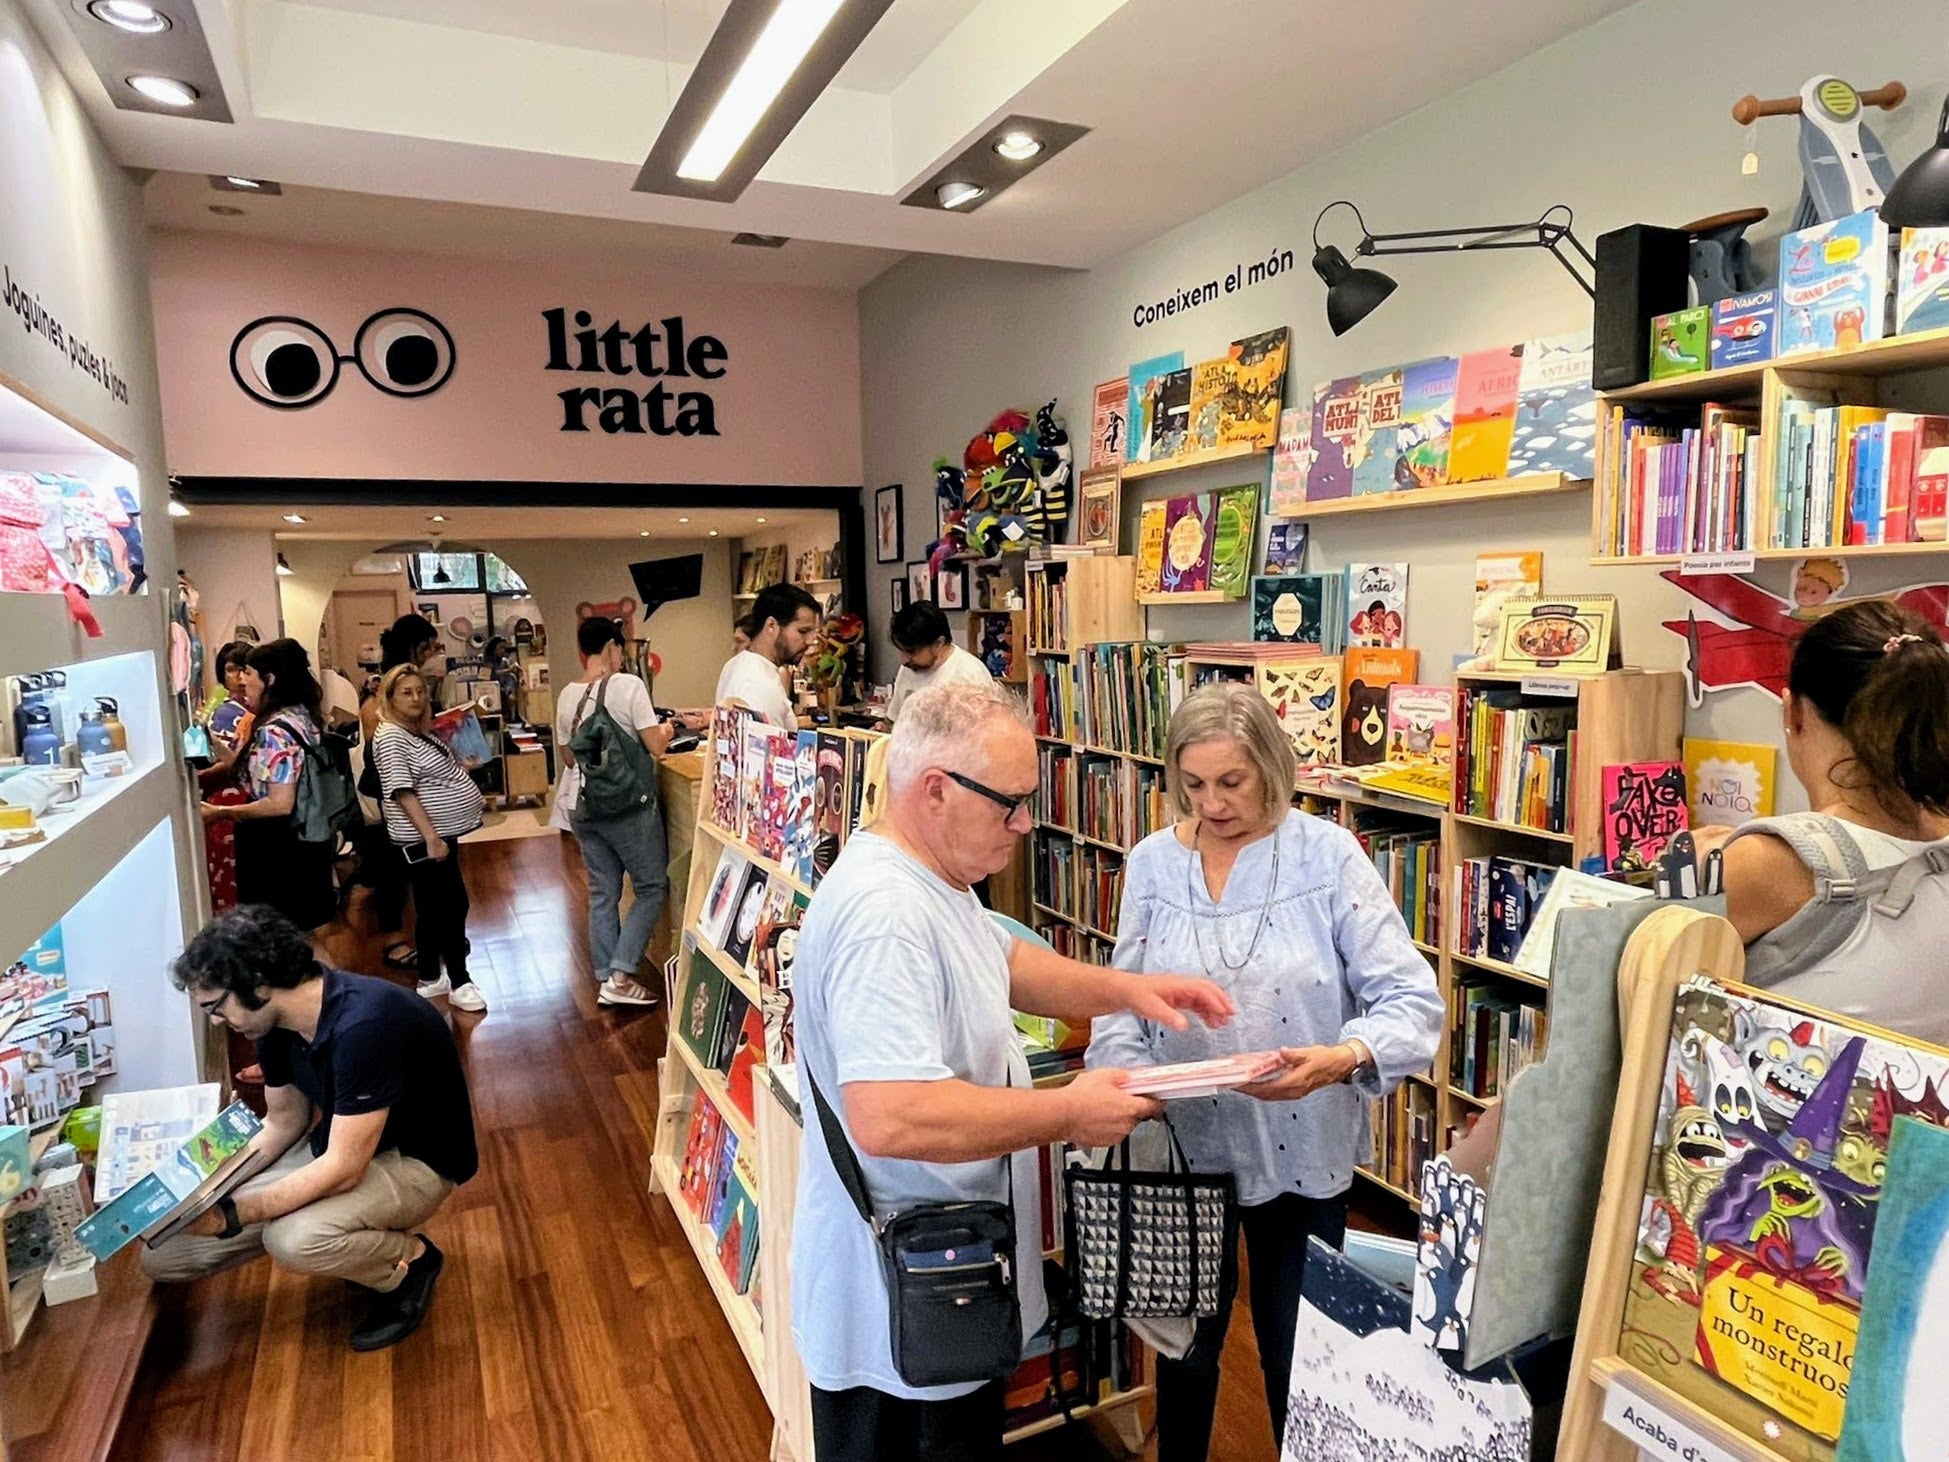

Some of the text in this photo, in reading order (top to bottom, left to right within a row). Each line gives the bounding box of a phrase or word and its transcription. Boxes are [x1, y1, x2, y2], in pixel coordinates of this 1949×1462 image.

[1133, 247, 1293, 328] Coneixem el món
[541, 307, 729, 380] little
[556, 380, 721, 437] rata
[1728, 1286, 1765, 1326] Un
[1712, 1315, 1849, 1399] monstruos
[1622, 1405, 1678, 1453] Acaba
